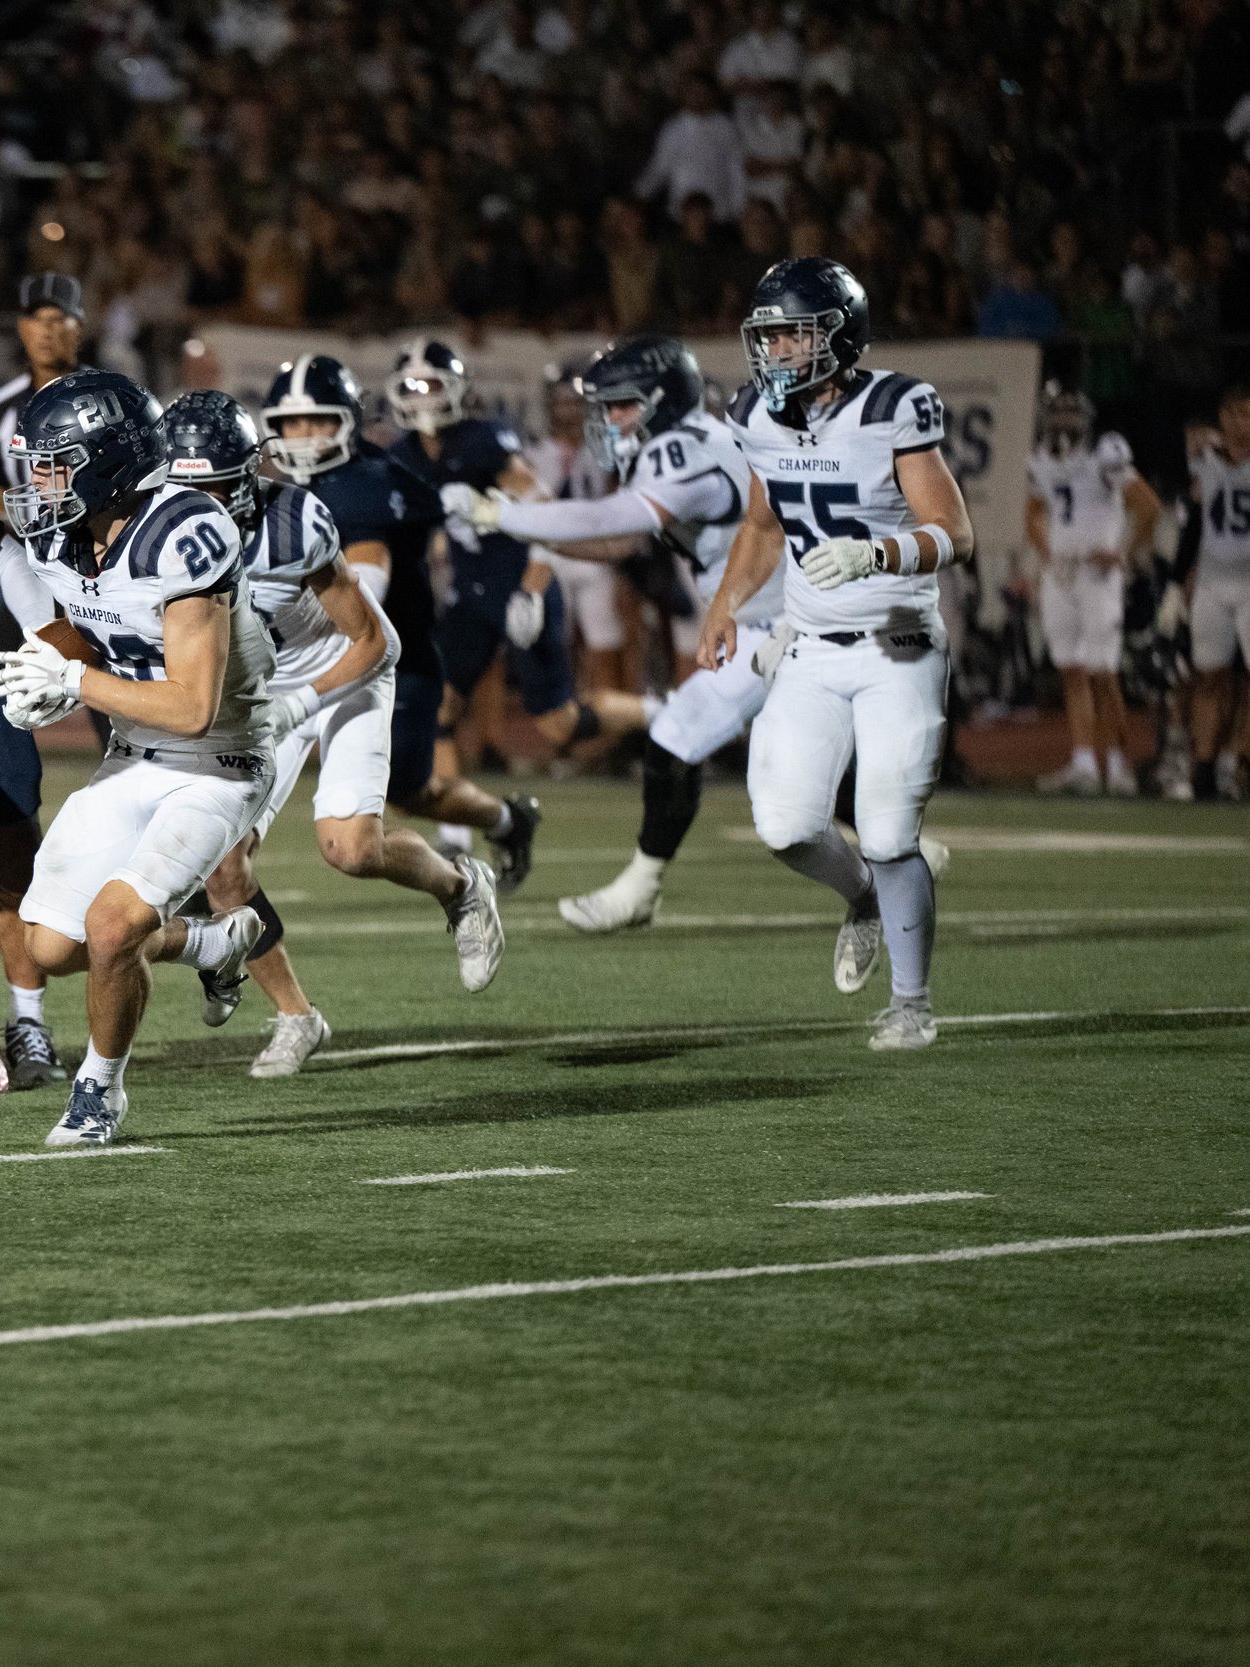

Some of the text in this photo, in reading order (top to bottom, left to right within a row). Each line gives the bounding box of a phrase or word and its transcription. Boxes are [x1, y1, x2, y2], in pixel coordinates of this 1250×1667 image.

[72, 389, 125, 434] 20
[910, 391, 942, 434] 55
[176, 461, 207, 469] Riddell
[648, 440, 686, 478] 78
[778, 458, 841, 473] CHAMPION
[766, 478, 873, 570] 55
[175, 521, 228, 582] 20
[69, 603, 123, 626] CHAMPION
